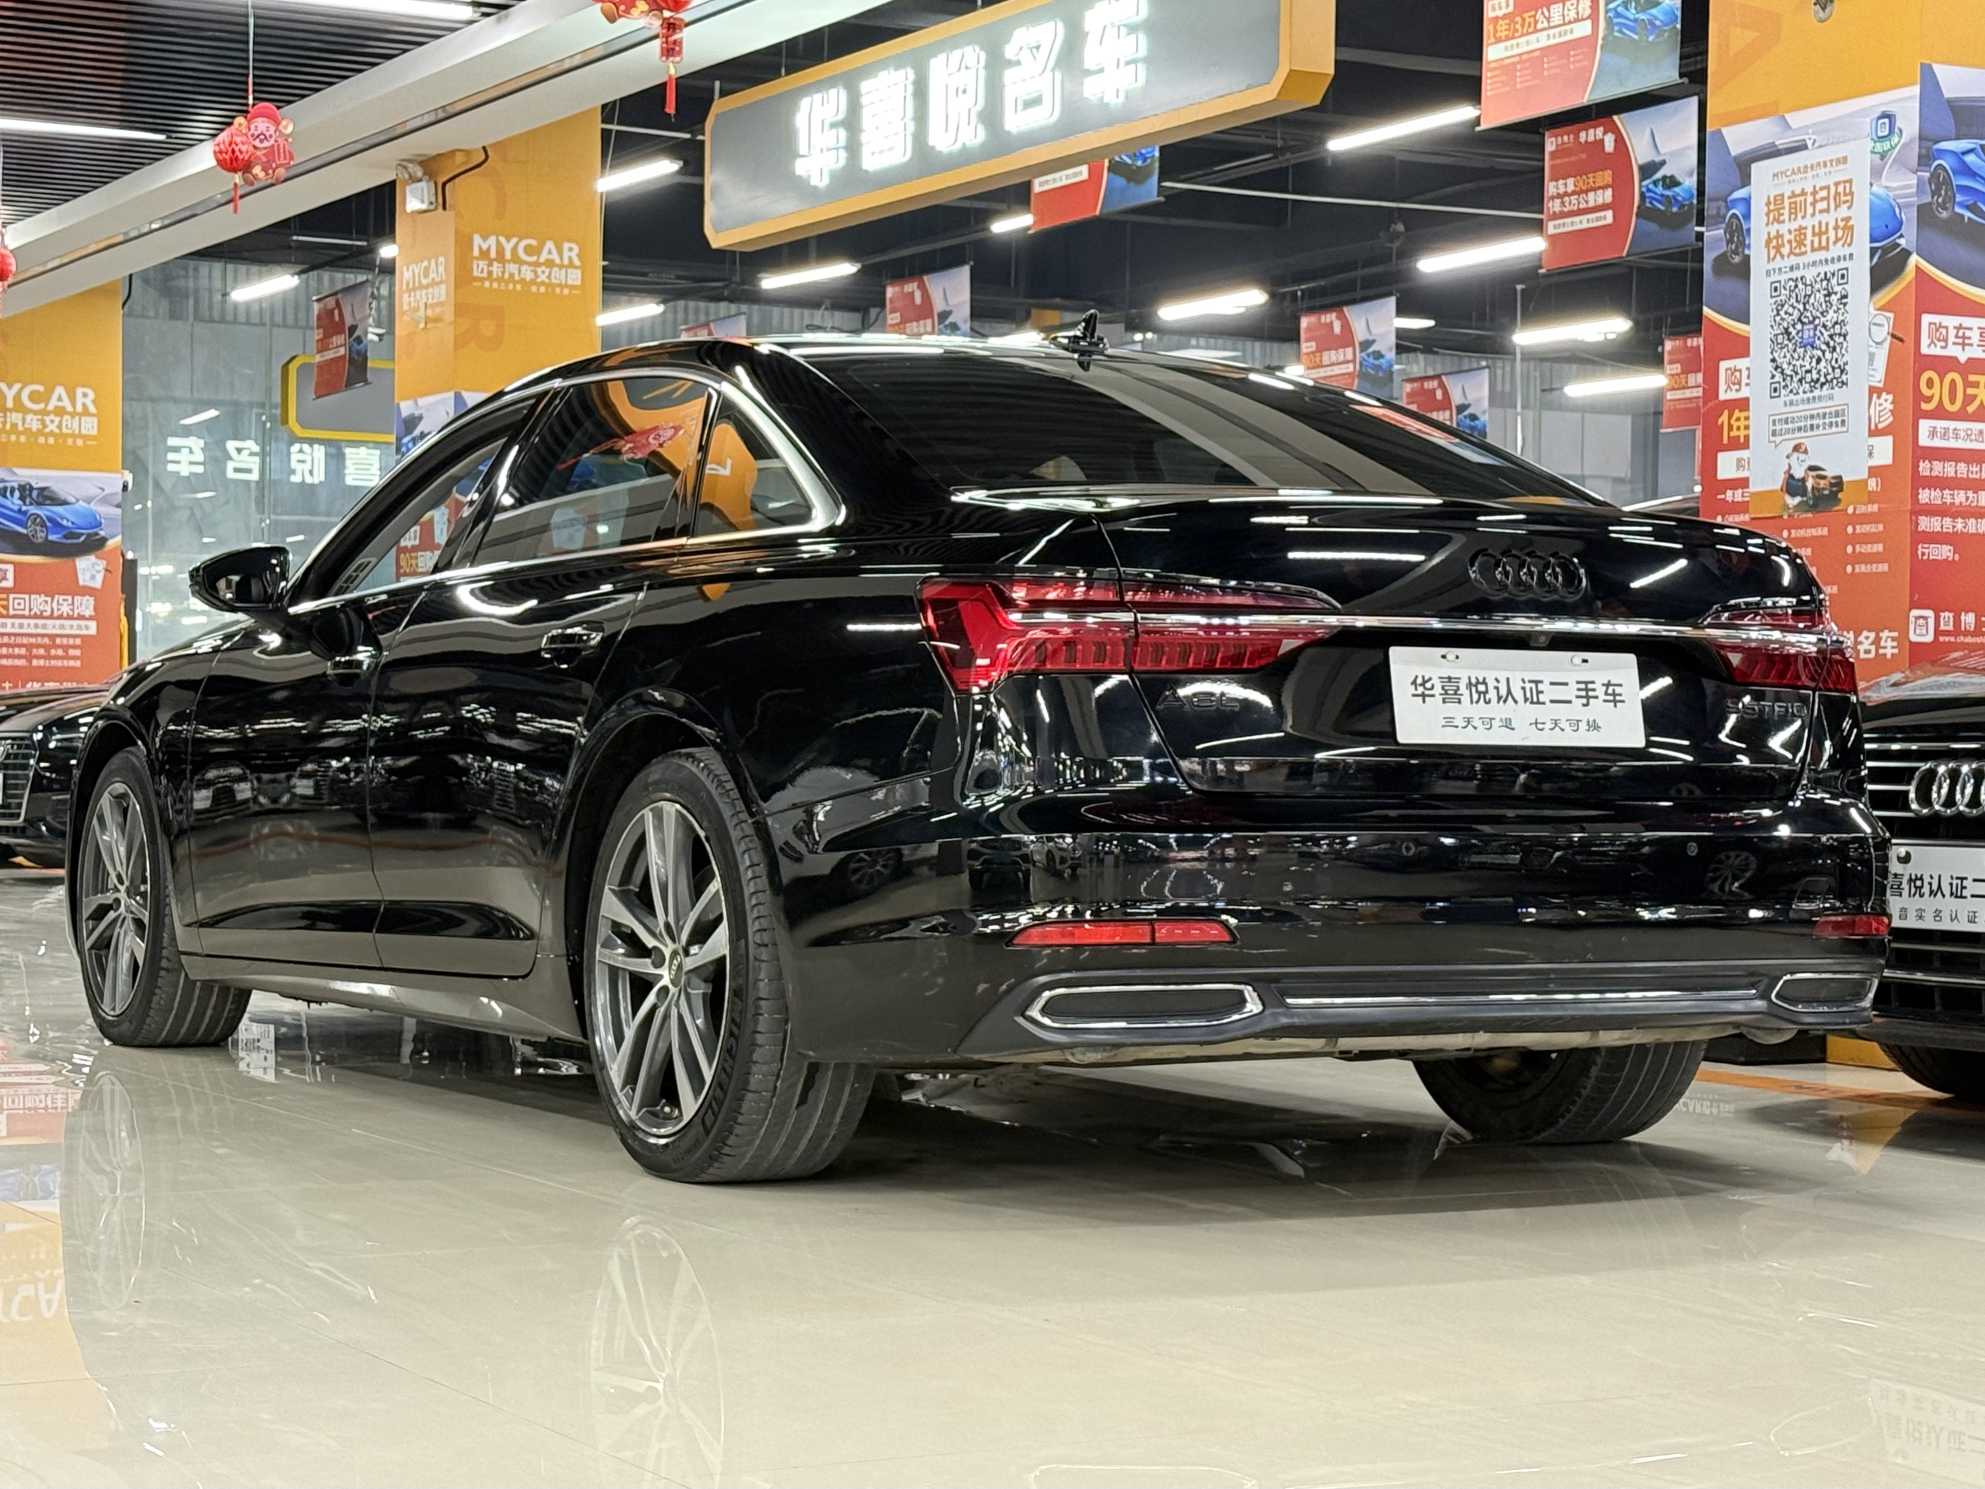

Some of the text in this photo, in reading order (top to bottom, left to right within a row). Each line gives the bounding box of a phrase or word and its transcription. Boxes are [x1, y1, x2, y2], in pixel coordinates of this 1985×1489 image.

[795, 0, 1150, 188] 华喜悦名车
[1764, 177, 1855, 227] 提前扫码
[472, 233, 582, 266] MYCAR
[1764, 216, 1855, 265] 快速出场
[402, 256, 446, 289] MYCAR
[472, 260, 582, 286] 迈卡汽车文创园
[1724, 364, 1751, 394] 购
[1409, 674, 1627, 709] 华喜悦认证二手车
[1441, 716, 1603, 733] 三天可退 七天可换
